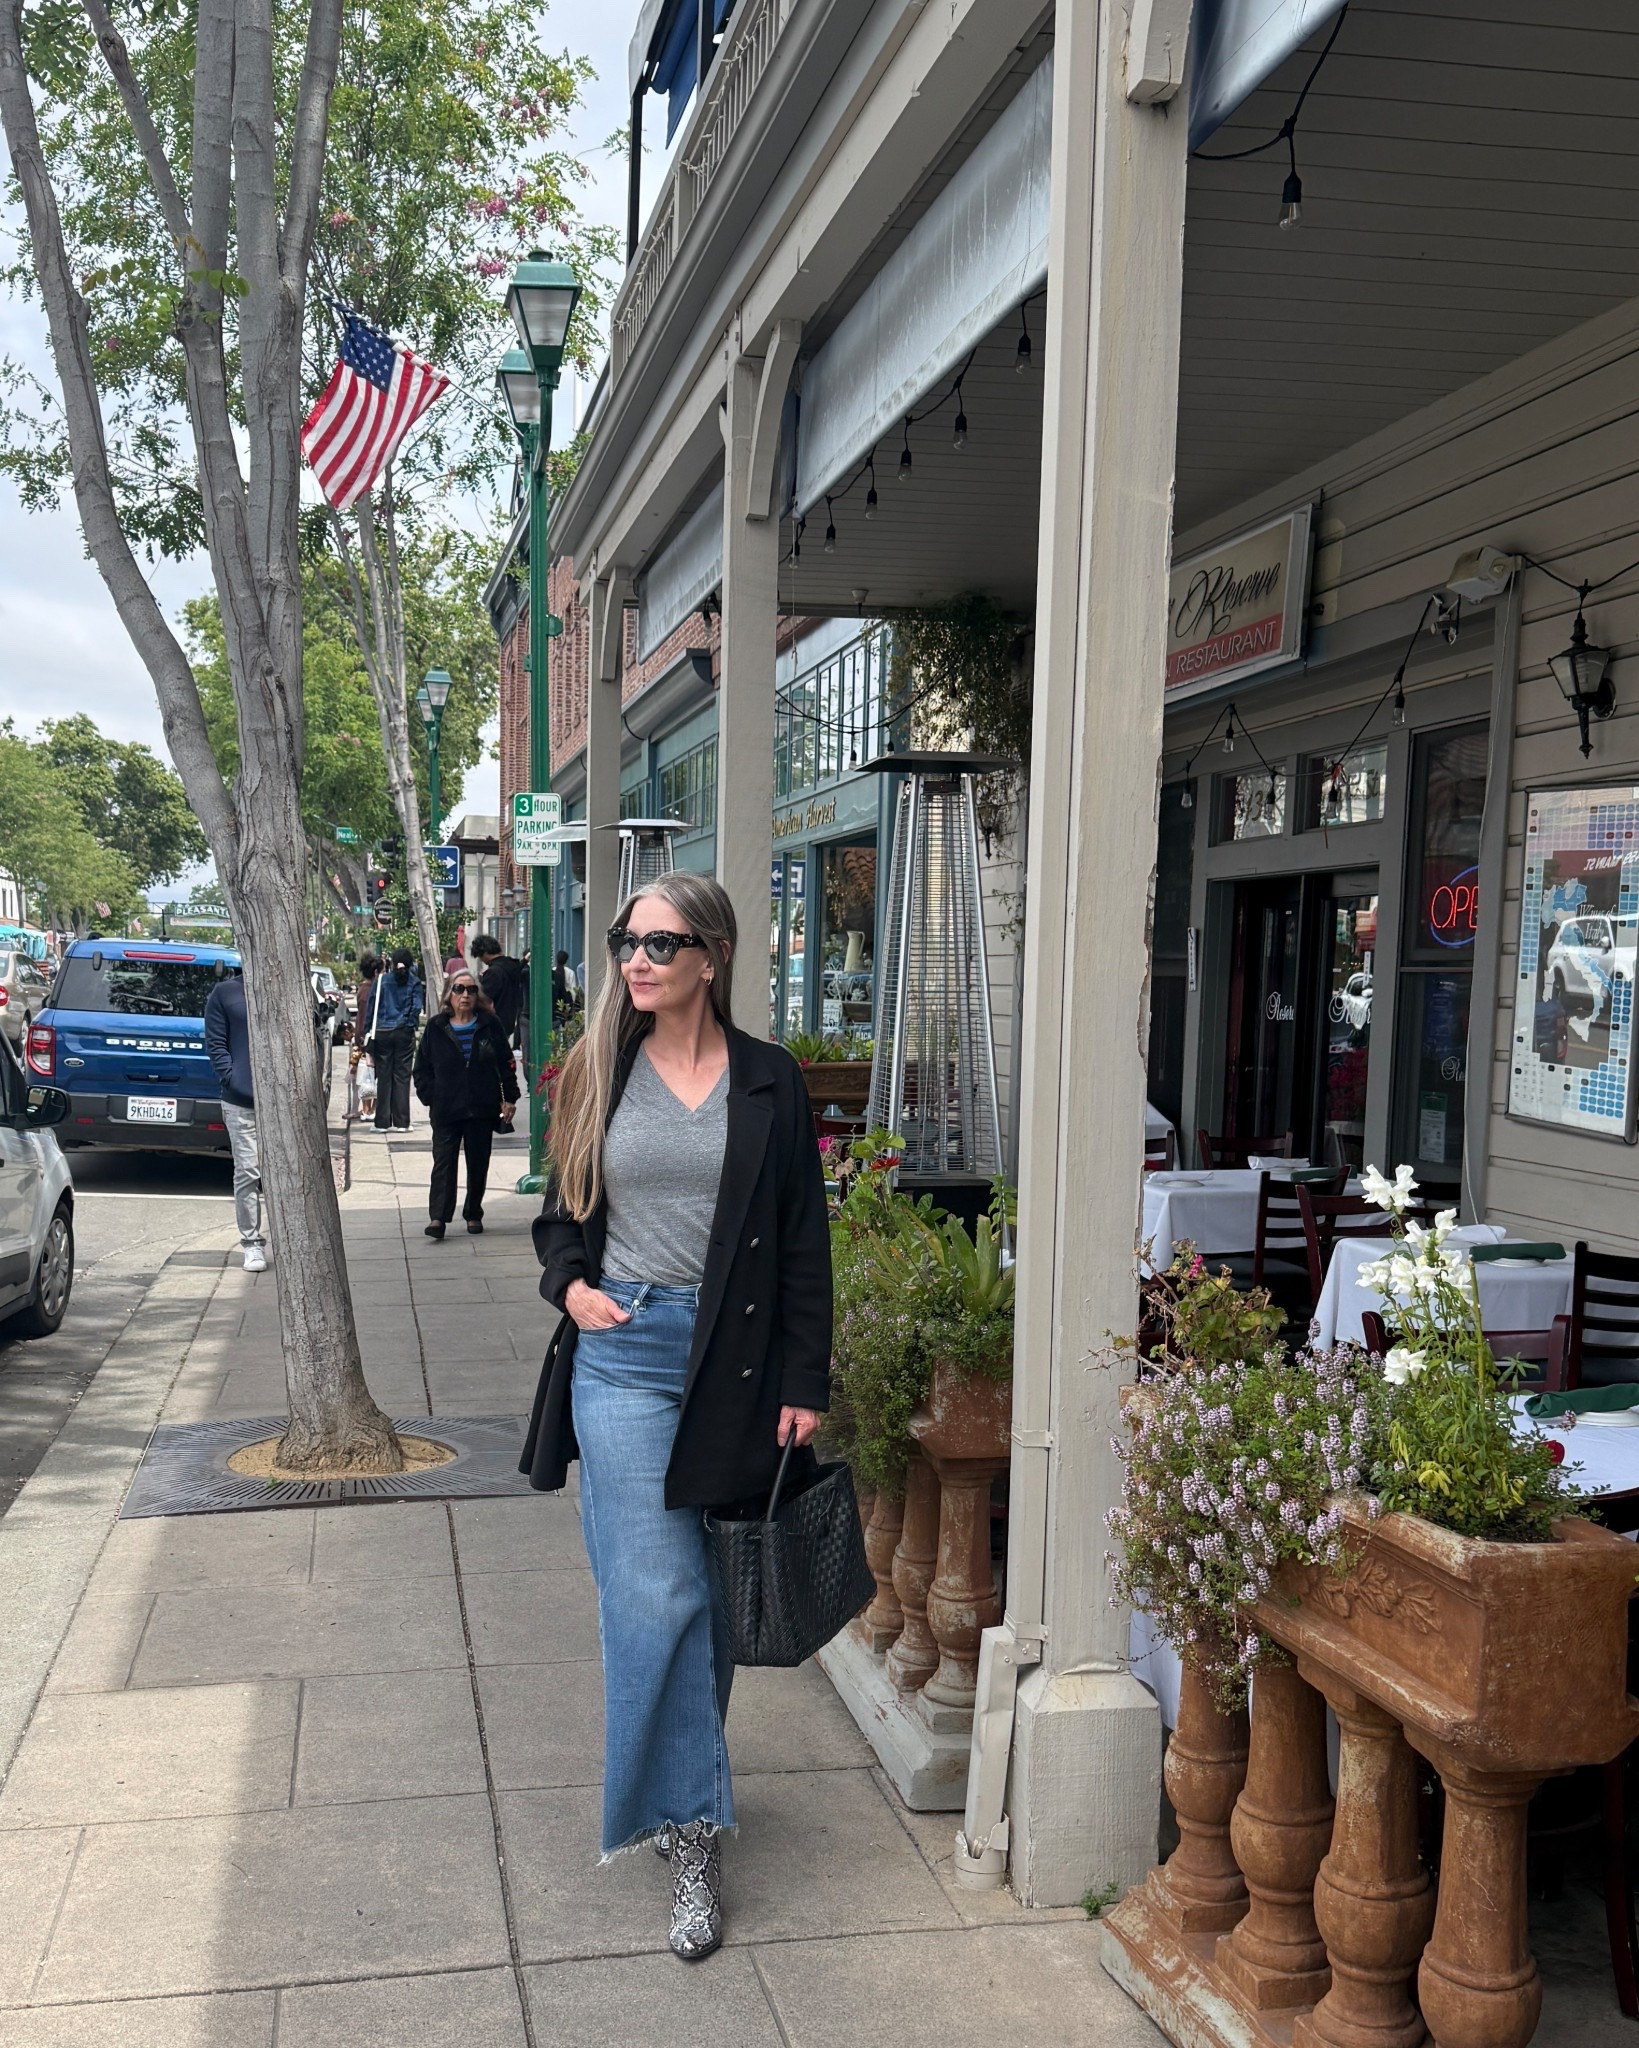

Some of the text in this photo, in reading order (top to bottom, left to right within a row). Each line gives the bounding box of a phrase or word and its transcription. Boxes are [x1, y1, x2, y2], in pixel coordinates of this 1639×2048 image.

[1176, 562, 1281, 641] Reserve
[1176, 621, 1276, 675] RESTAURANT
[519, 798, 558, 813] 3 HOUR
[805, 796, 837, 829] Harvest
[1431, 886, 1479, 928] OPE
[106, 1038, 203, 1050] BRONCO
[130, 1105, 174, 1119] 9KHD416
